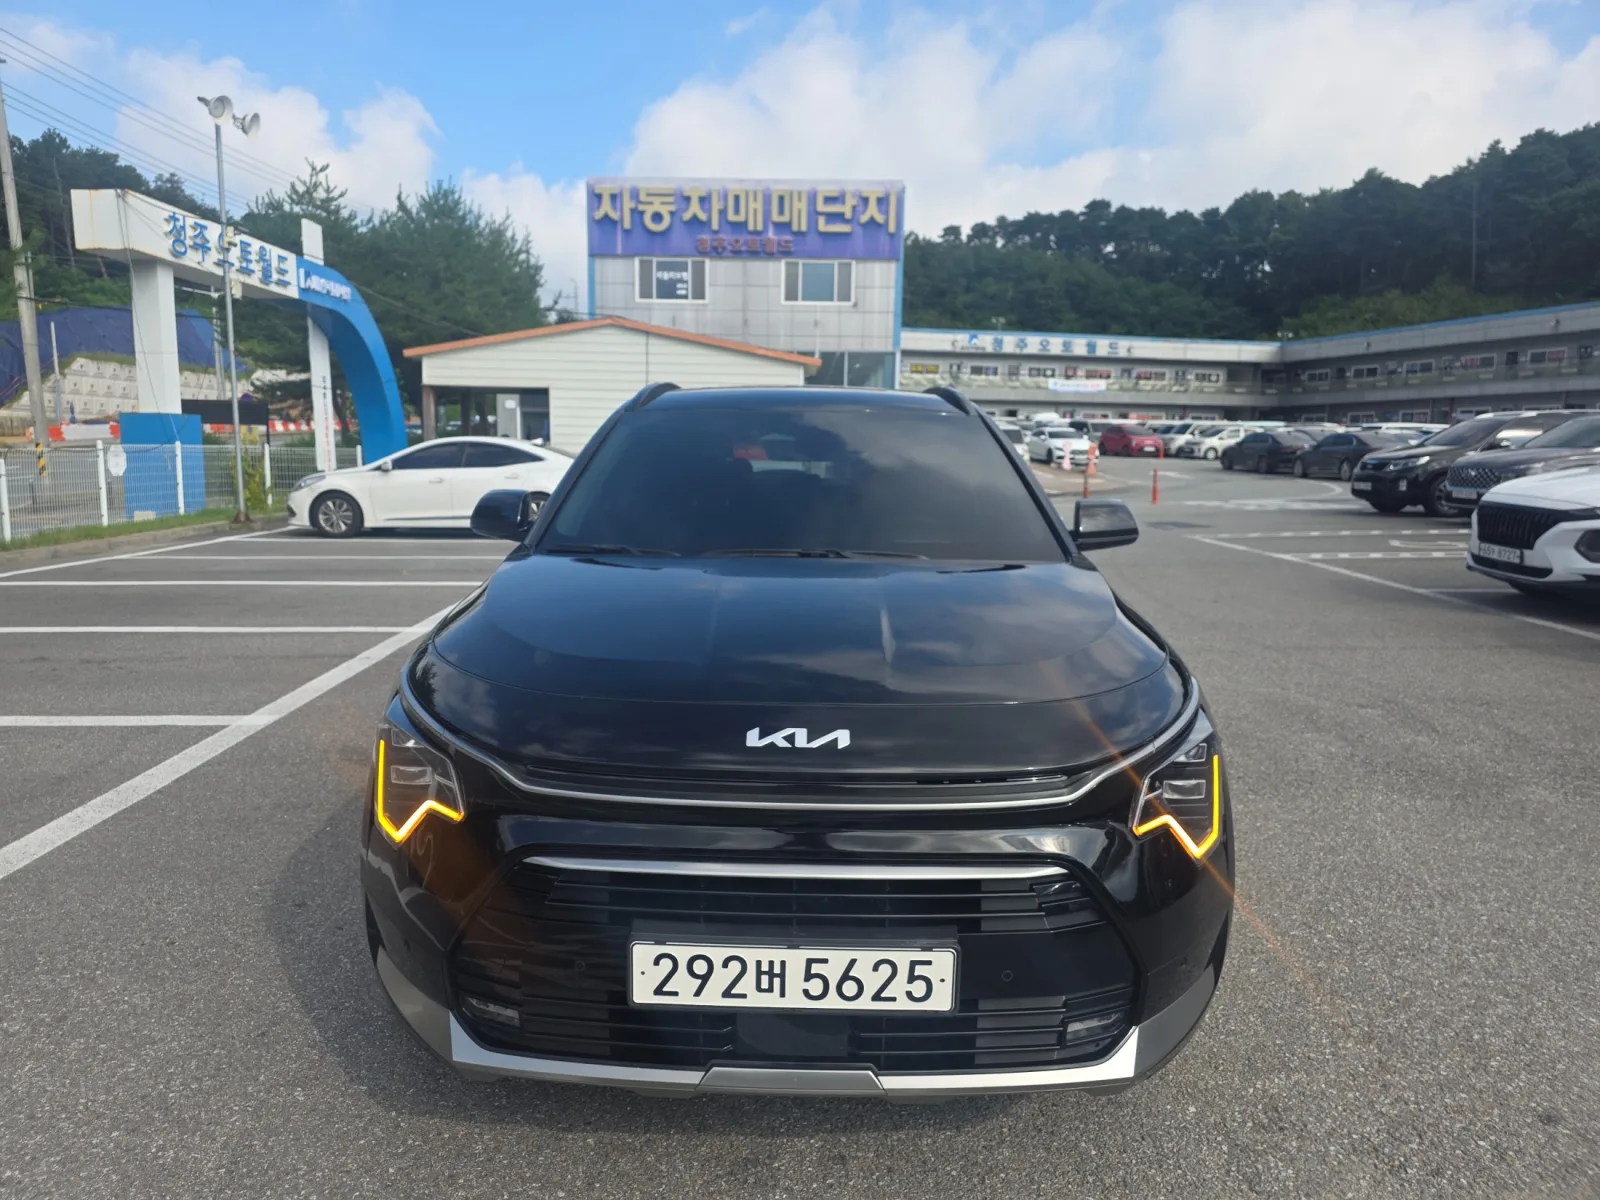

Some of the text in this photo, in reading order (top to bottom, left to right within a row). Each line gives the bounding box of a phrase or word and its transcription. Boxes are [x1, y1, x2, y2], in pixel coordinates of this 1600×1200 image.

[593, 186, 897, 234] 자동차매매단지
[746, 727, 850, 749] KIA
[801, 957, 934, 1003] 5625
